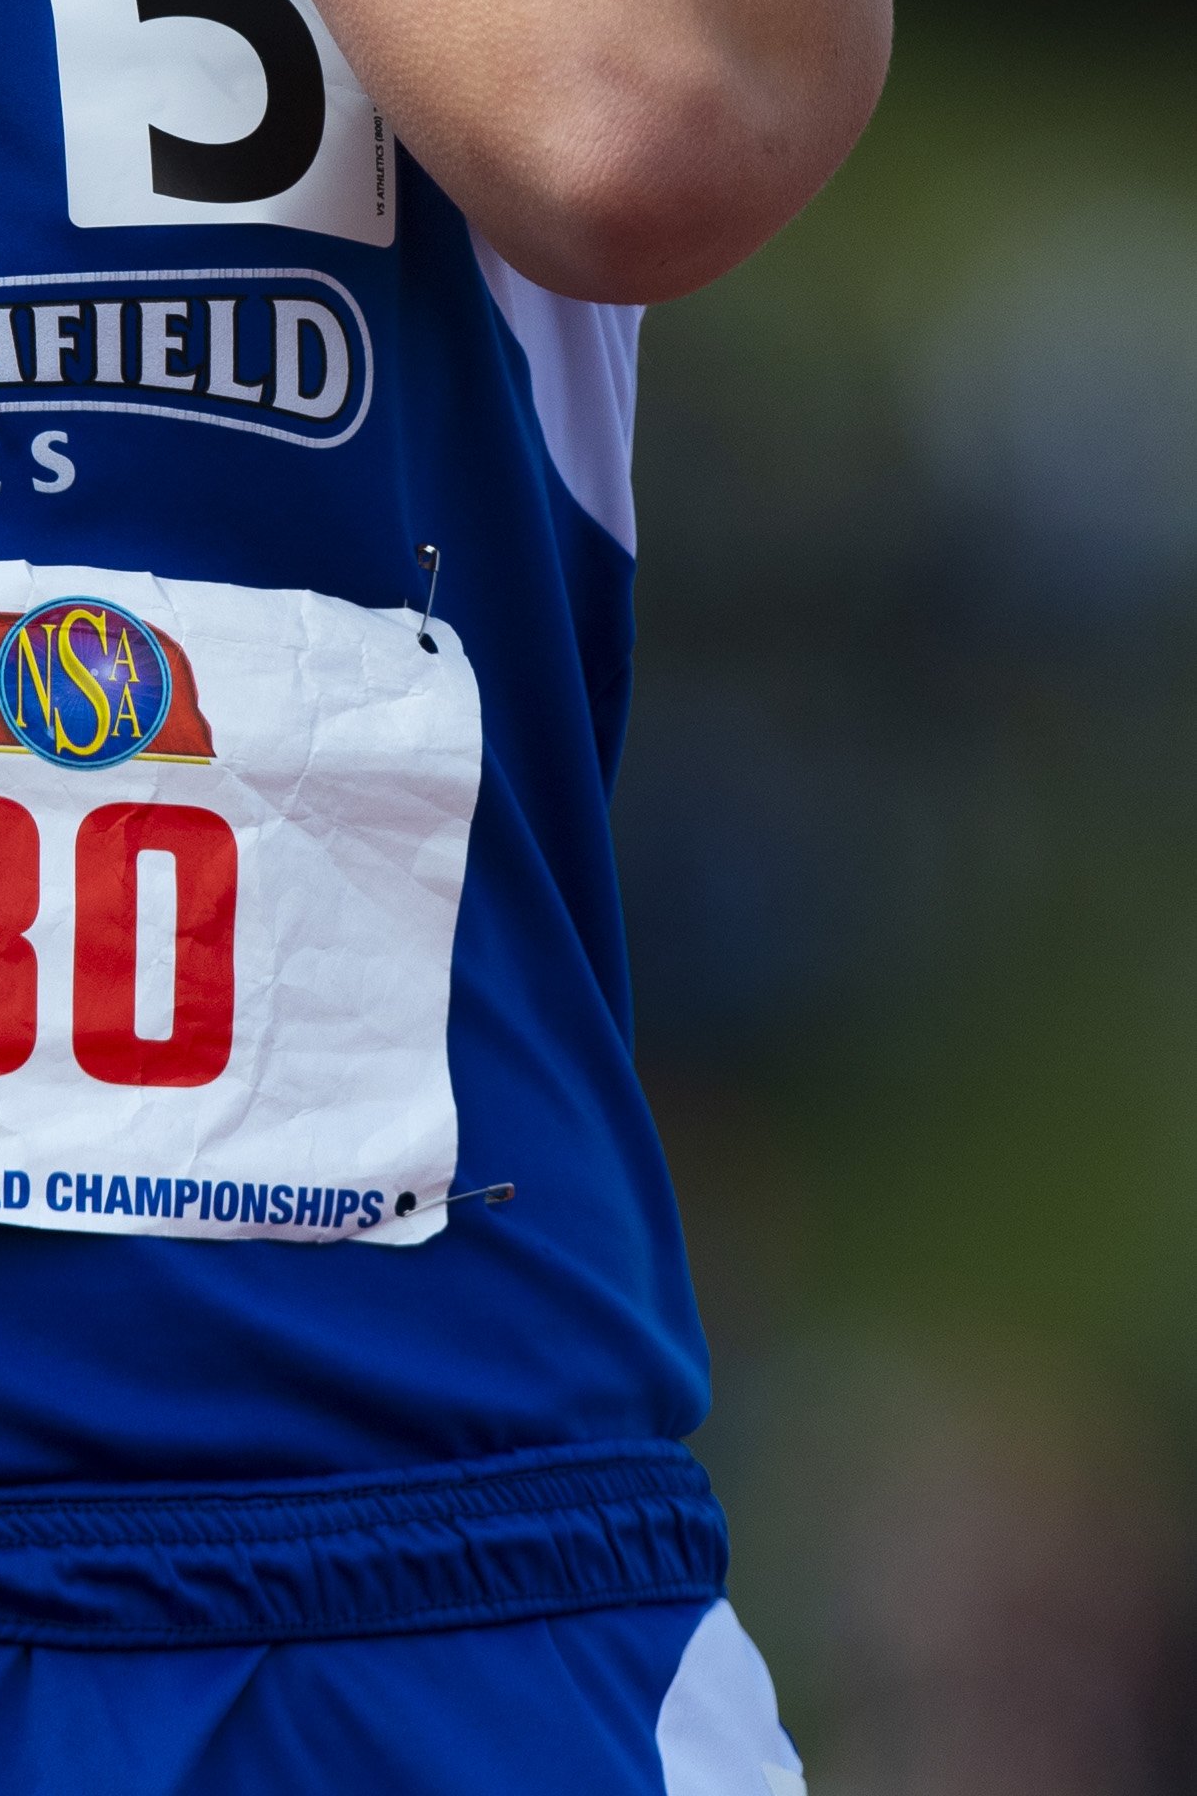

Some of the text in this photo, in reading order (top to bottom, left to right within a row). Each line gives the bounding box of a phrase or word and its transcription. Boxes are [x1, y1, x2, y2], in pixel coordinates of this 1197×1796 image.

[373, 115, 385, 142] (800)
[375, 144, 385, 200] ATHLETICS
[376, 201, 385, 217] VS
[45, 1171, 384, 1229] CHAMPIONSHIPS
